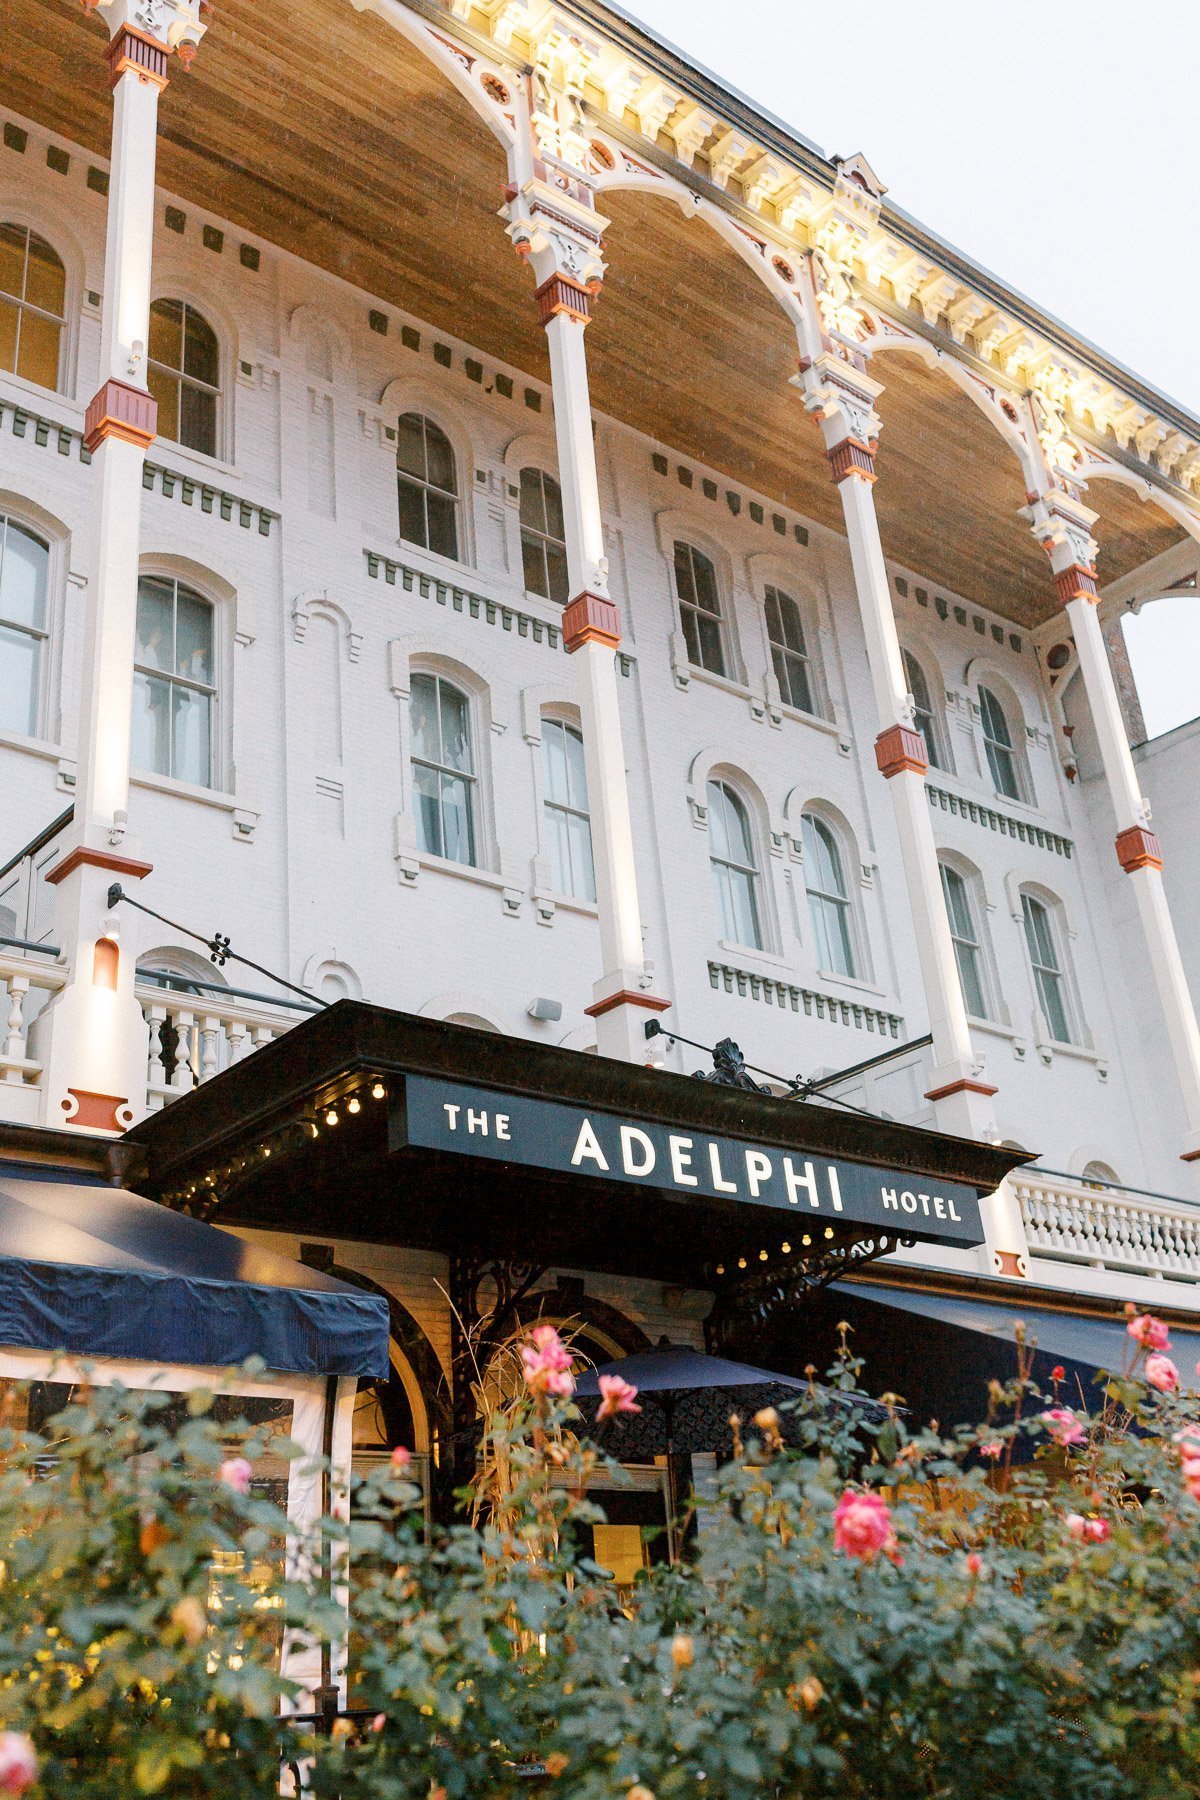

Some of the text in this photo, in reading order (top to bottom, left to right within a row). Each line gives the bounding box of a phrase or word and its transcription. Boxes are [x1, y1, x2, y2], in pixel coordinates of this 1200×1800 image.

[443, 1103, 962, 1222] THE ADELPHI HOTEL
